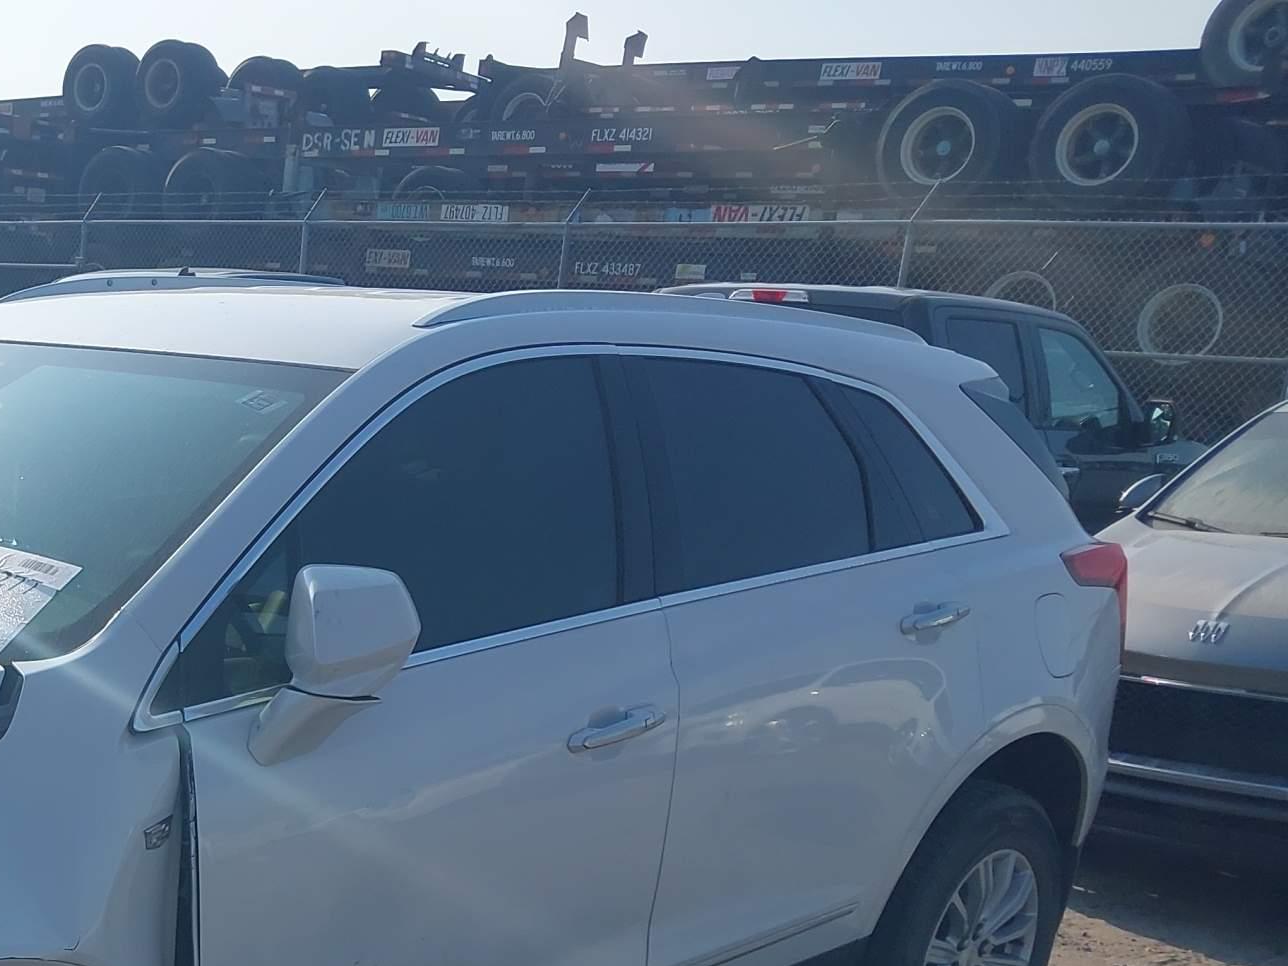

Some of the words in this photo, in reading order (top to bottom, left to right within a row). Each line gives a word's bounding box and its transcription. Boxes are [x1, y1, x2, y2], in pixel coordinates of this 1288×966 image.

[822, 62, 880, 78] FLEXI-VAN
[384, 128, 439, 146] FLEXI-VAN
[591, 128, 615, 142] FLXZ
[619, 127, 653, 141] 414321
[712, 205, 806, 223] FLEXI-VAN
[575, 261, 598, 275] FLXZ
